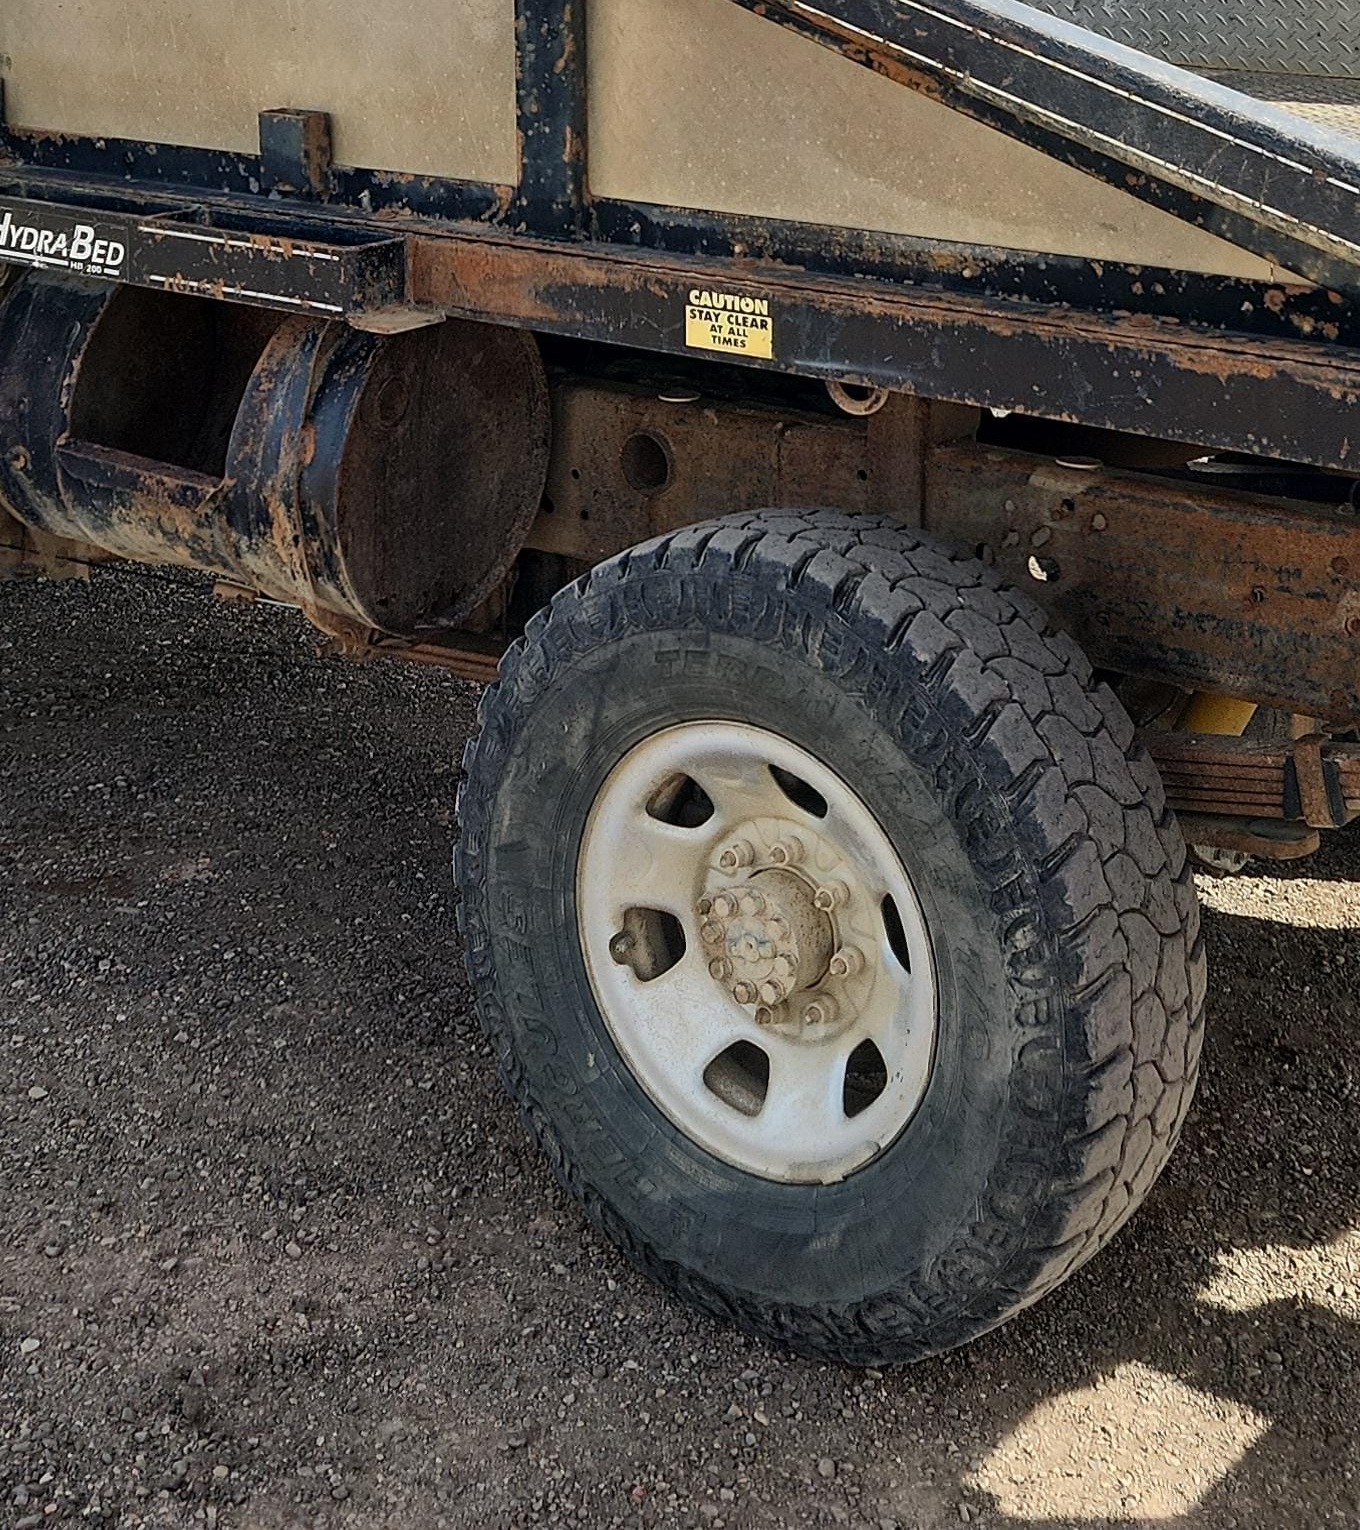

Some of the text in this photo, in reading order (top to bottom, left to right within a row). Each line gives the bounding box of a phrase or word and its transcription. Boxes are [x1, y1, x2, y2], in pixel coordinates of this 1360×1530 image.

[689, 289, 769, 316] CAUTION
[689, 308, 769, 331] STAY CLEAR
[709, 323, 748, 338] AT ALL
[711, 335, 747, 348] TIMES
